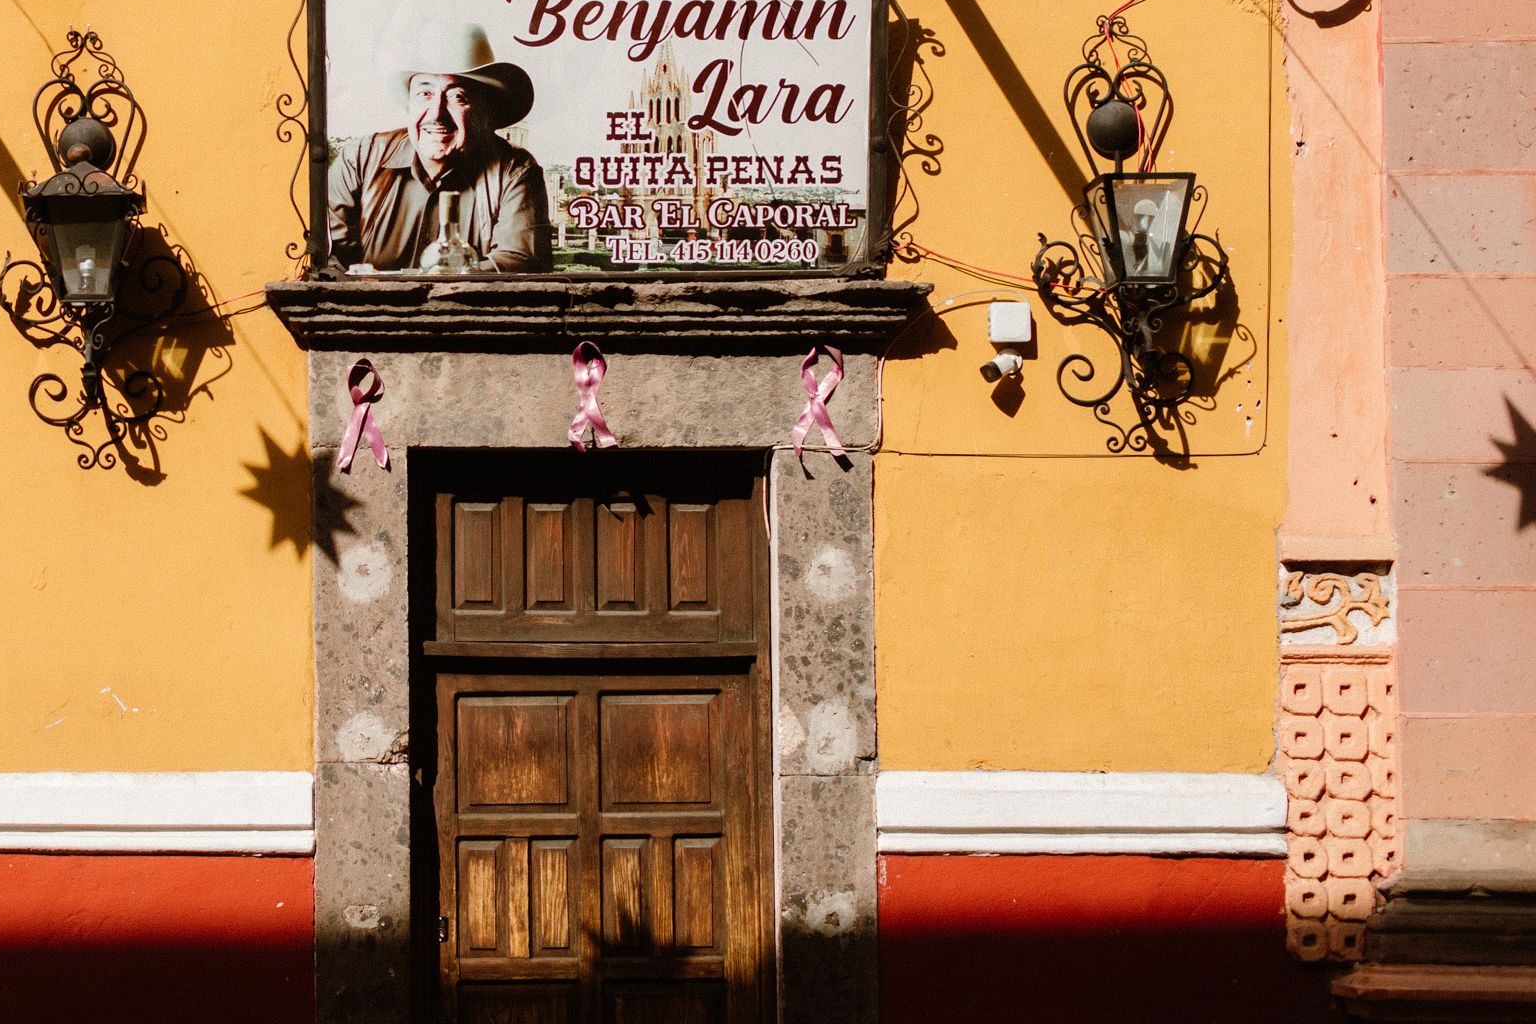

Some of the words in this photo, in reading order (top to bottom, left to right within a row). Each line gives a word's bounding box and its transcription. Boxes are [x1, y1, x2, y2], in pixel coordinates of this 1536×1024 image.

[687, 59, 854, 137] Lara
[606, 111, 652, 141] EL
[574, 155, 694, 187] QUITA
[706, 155, 843, 184] PENAS
[568, 196, 645, 229] BAR
[652, 198, 702, 229] EL
[707, 198, 858, 229] CAPORAL
[671, 239, 711, 263] 415
[716, 239, 751, 263] 114
[755, 239, 818, 263] 0260
